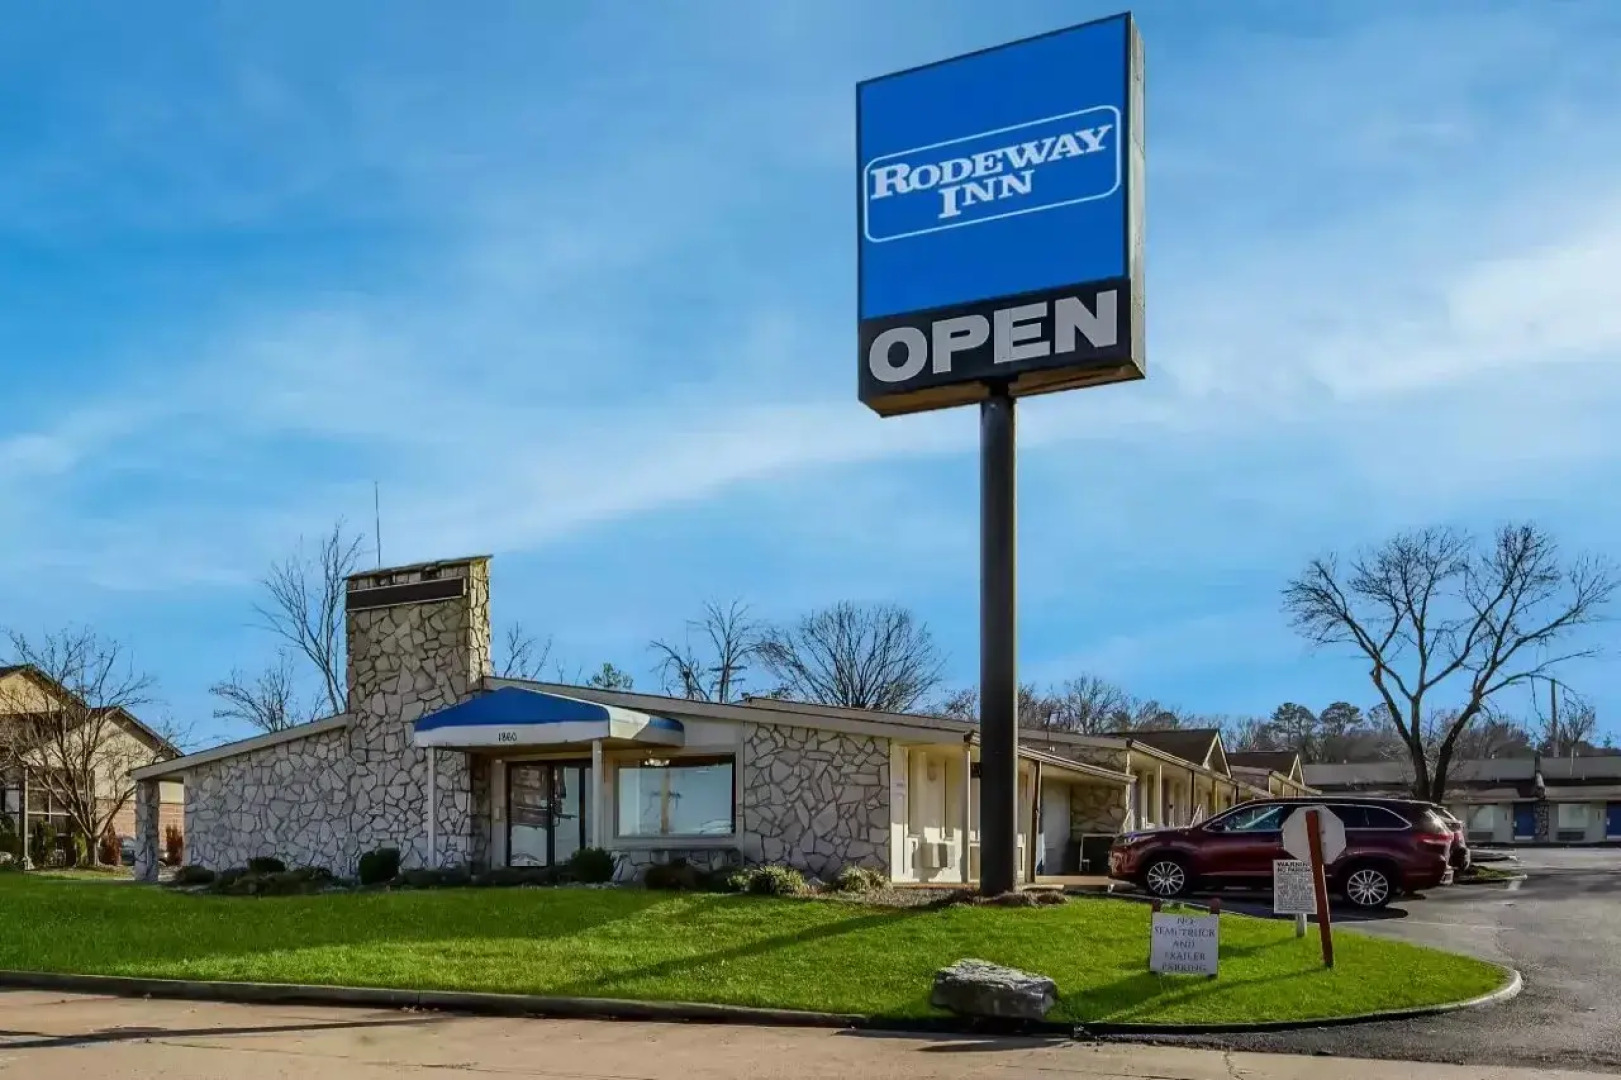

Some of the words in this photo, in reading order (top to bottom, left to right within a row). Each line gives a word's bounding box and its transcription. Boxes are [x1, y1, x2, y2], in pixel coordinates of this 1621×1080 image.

[870, 123, 1113, 200] RODEWAY
[938, 169, 1036, 219] INN
[868, 289, 1118, 383] OPEN
[498, 731, 518, 742] 1860
[1177, 917, 1196, 925] NO
[1173, 940, 1195, 949] AND
